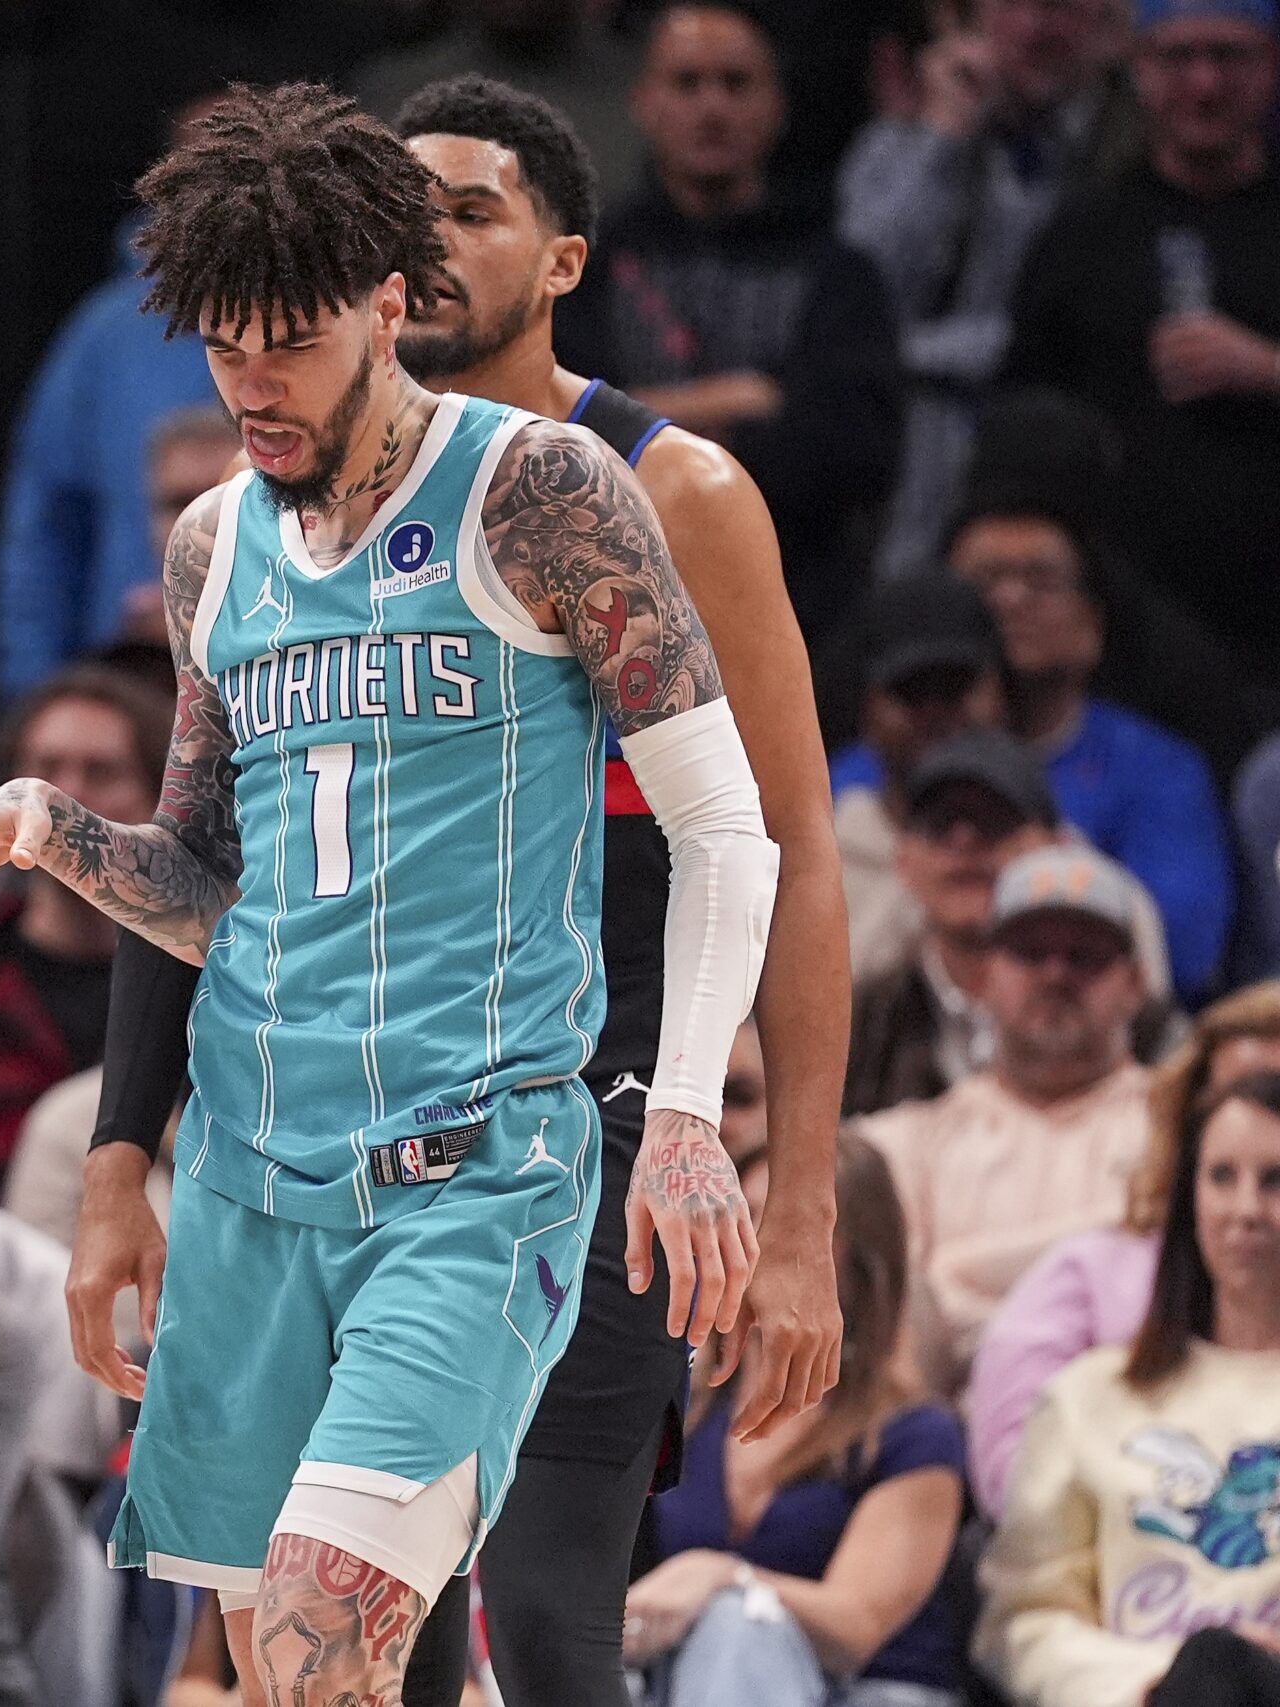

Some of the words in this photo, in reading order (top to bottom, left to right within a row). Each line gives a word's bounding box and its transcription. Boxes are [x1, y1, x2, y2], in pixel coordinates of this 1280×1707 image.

[374, 578, 406, 596] Judi
[409, 564, 448, 589] Health
[223, 633, 484, 749] HORNETS
[303, 742, 355, 899] 1
[428, 1147, 440, 1157] 44
[649, 1141, 683, 1170] NOT
[666, 1171, 733, 1199] HERE
